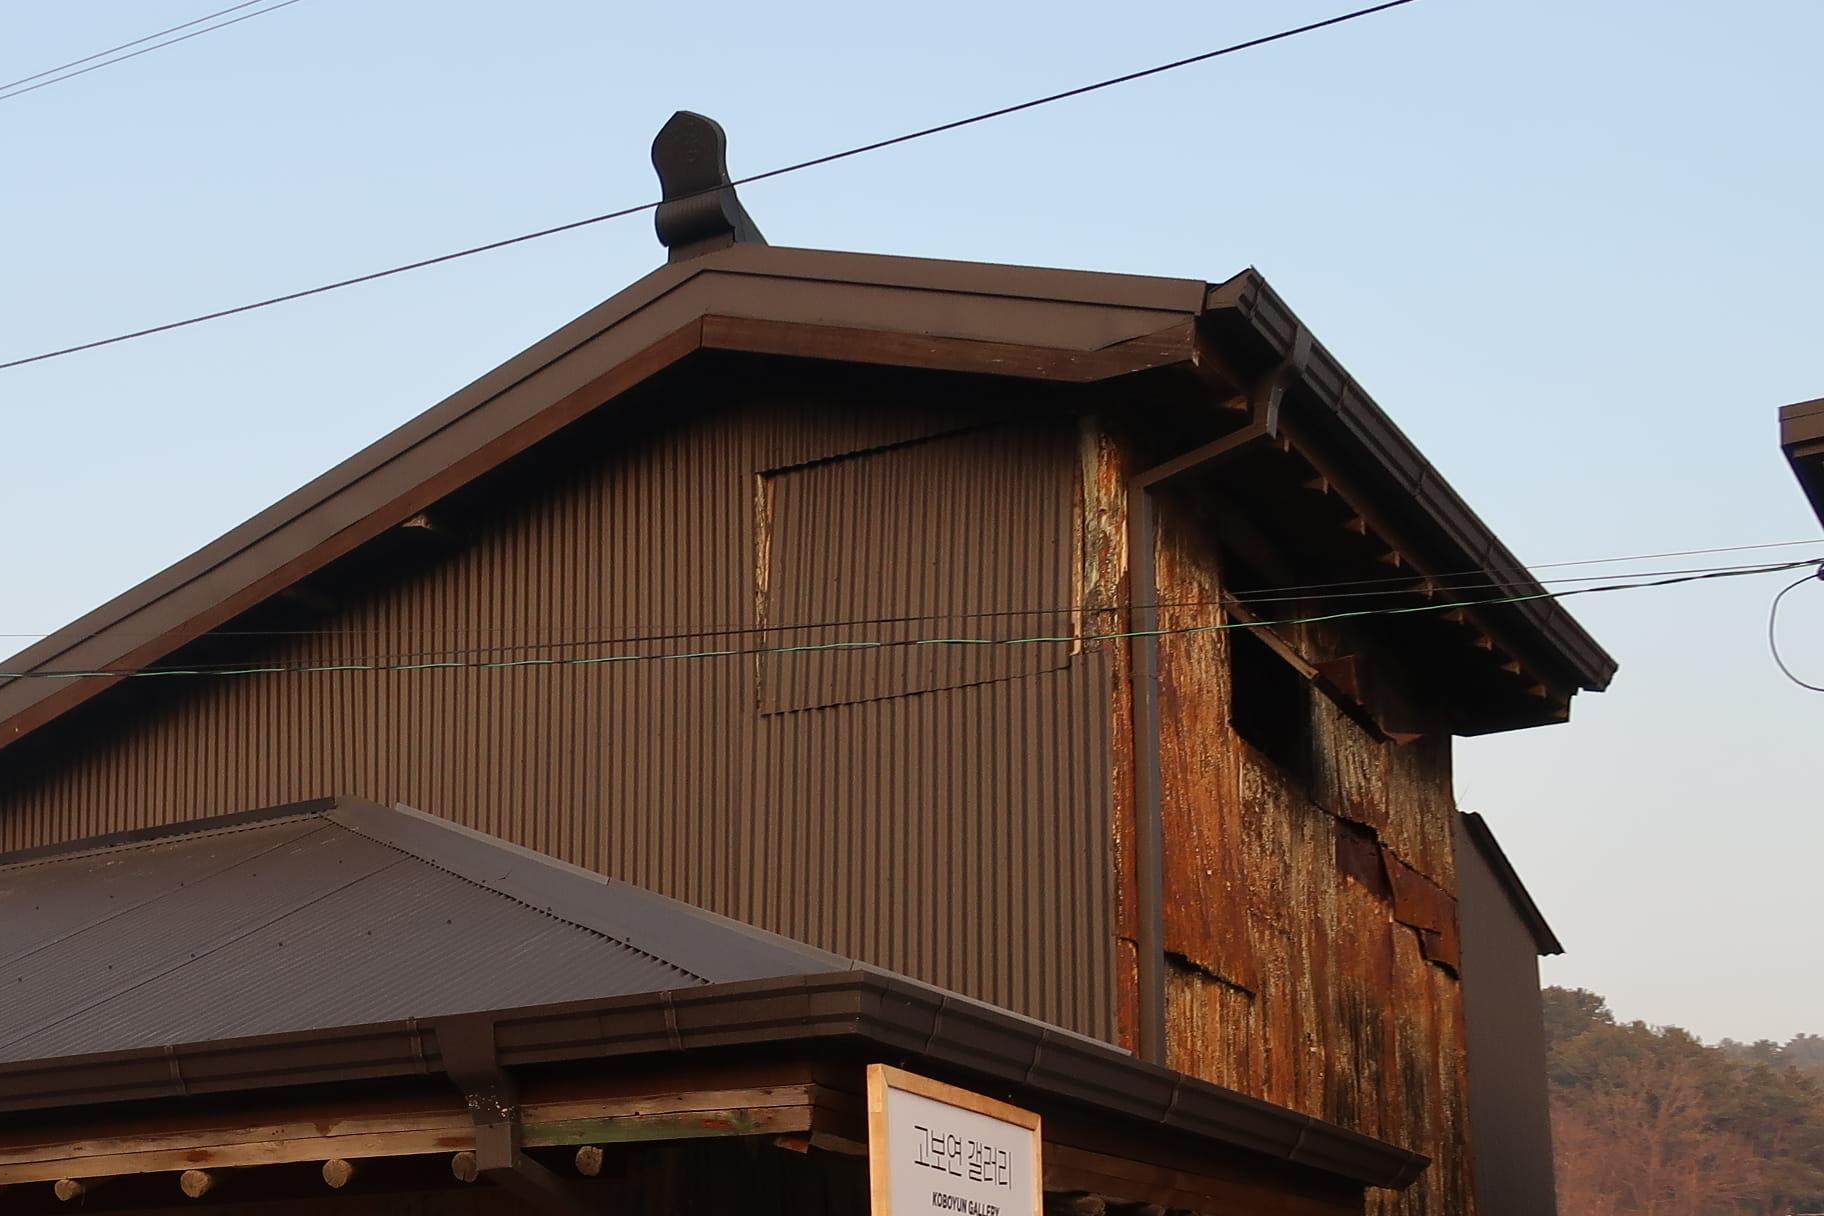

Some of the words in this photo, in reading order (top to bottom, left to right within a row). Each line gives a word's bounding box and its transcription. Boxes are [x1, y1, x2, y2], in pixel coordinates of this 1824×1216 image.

[914, 1124, 962, 1177] 고보연
[967, 1139, 1013, 1190] 갤러리
[932, 1191, 967, 1214] KOBOYUN
